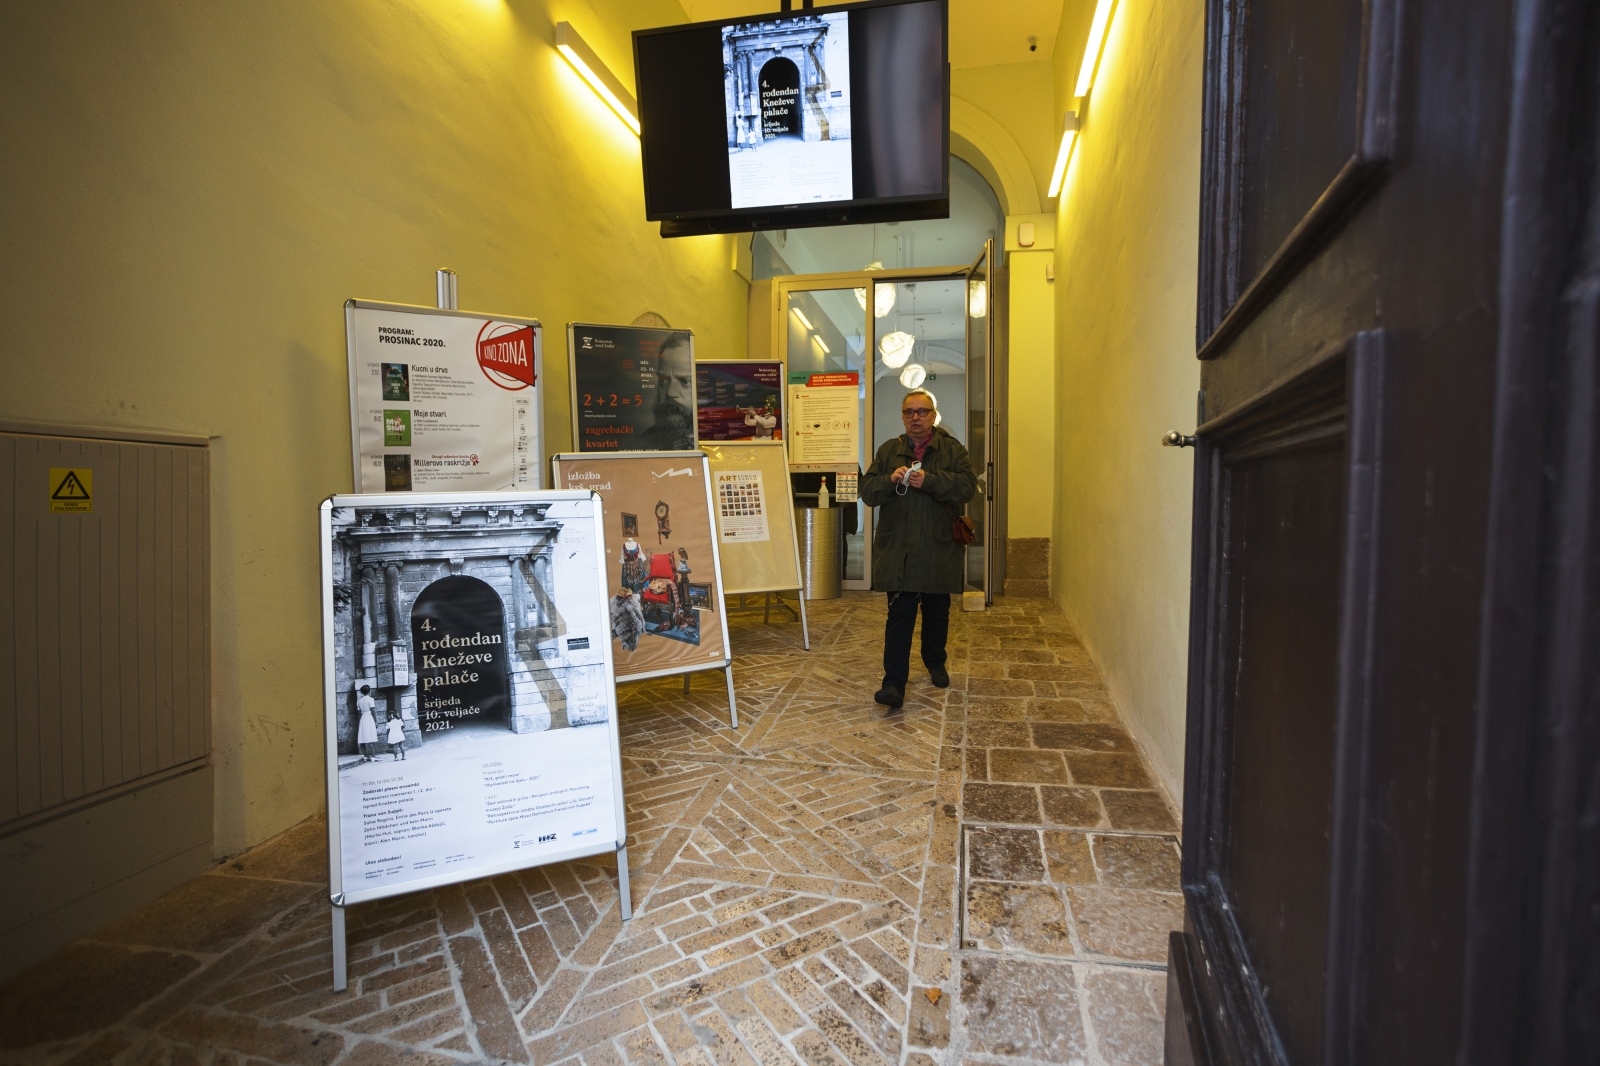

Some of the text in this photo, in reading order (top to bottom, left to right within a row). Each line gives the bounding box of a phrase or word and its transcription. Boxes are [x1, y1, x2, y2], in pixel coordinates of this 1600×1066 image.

[761, 79, 770, 88] 4.
[763, 97, 795, 107] Kneževe
[763, 107, 789, 119] palače
[378, 326, 415, 336] PROGRAM:
[379, 335, 446, 348] PROSINAC 2020.
[484, 339, 528, 367] KINO ZONA
[435, 365, 449, 374] drvo
[583, 393, 592, 407] 2
[609, 393, 618, 407] 2
[634, 394, 643, 407] 5
[413, 409, 447, 418] Moje stvari
[386, 418, 399, 427] My
[386, 424, 406, 432] Stuff
[585, 425, 634, 436] zagrebački
[585, 439, 619, 448] kvartet
[413, 459, 471, 467] Millerovo raskrižje
[567, 471, 601, 481] izložba
[420, 618, 437, 632] 4.
[422, 631, 502, 651] rođendan
[422, 651, 493, 669] Kneževe
[423, 669, 480, 692] palače
[424, 696, 461, 709] srijeda
[426, 705, 481, 720] 10. veljače
[425, 720, 454, 732] 2021.
